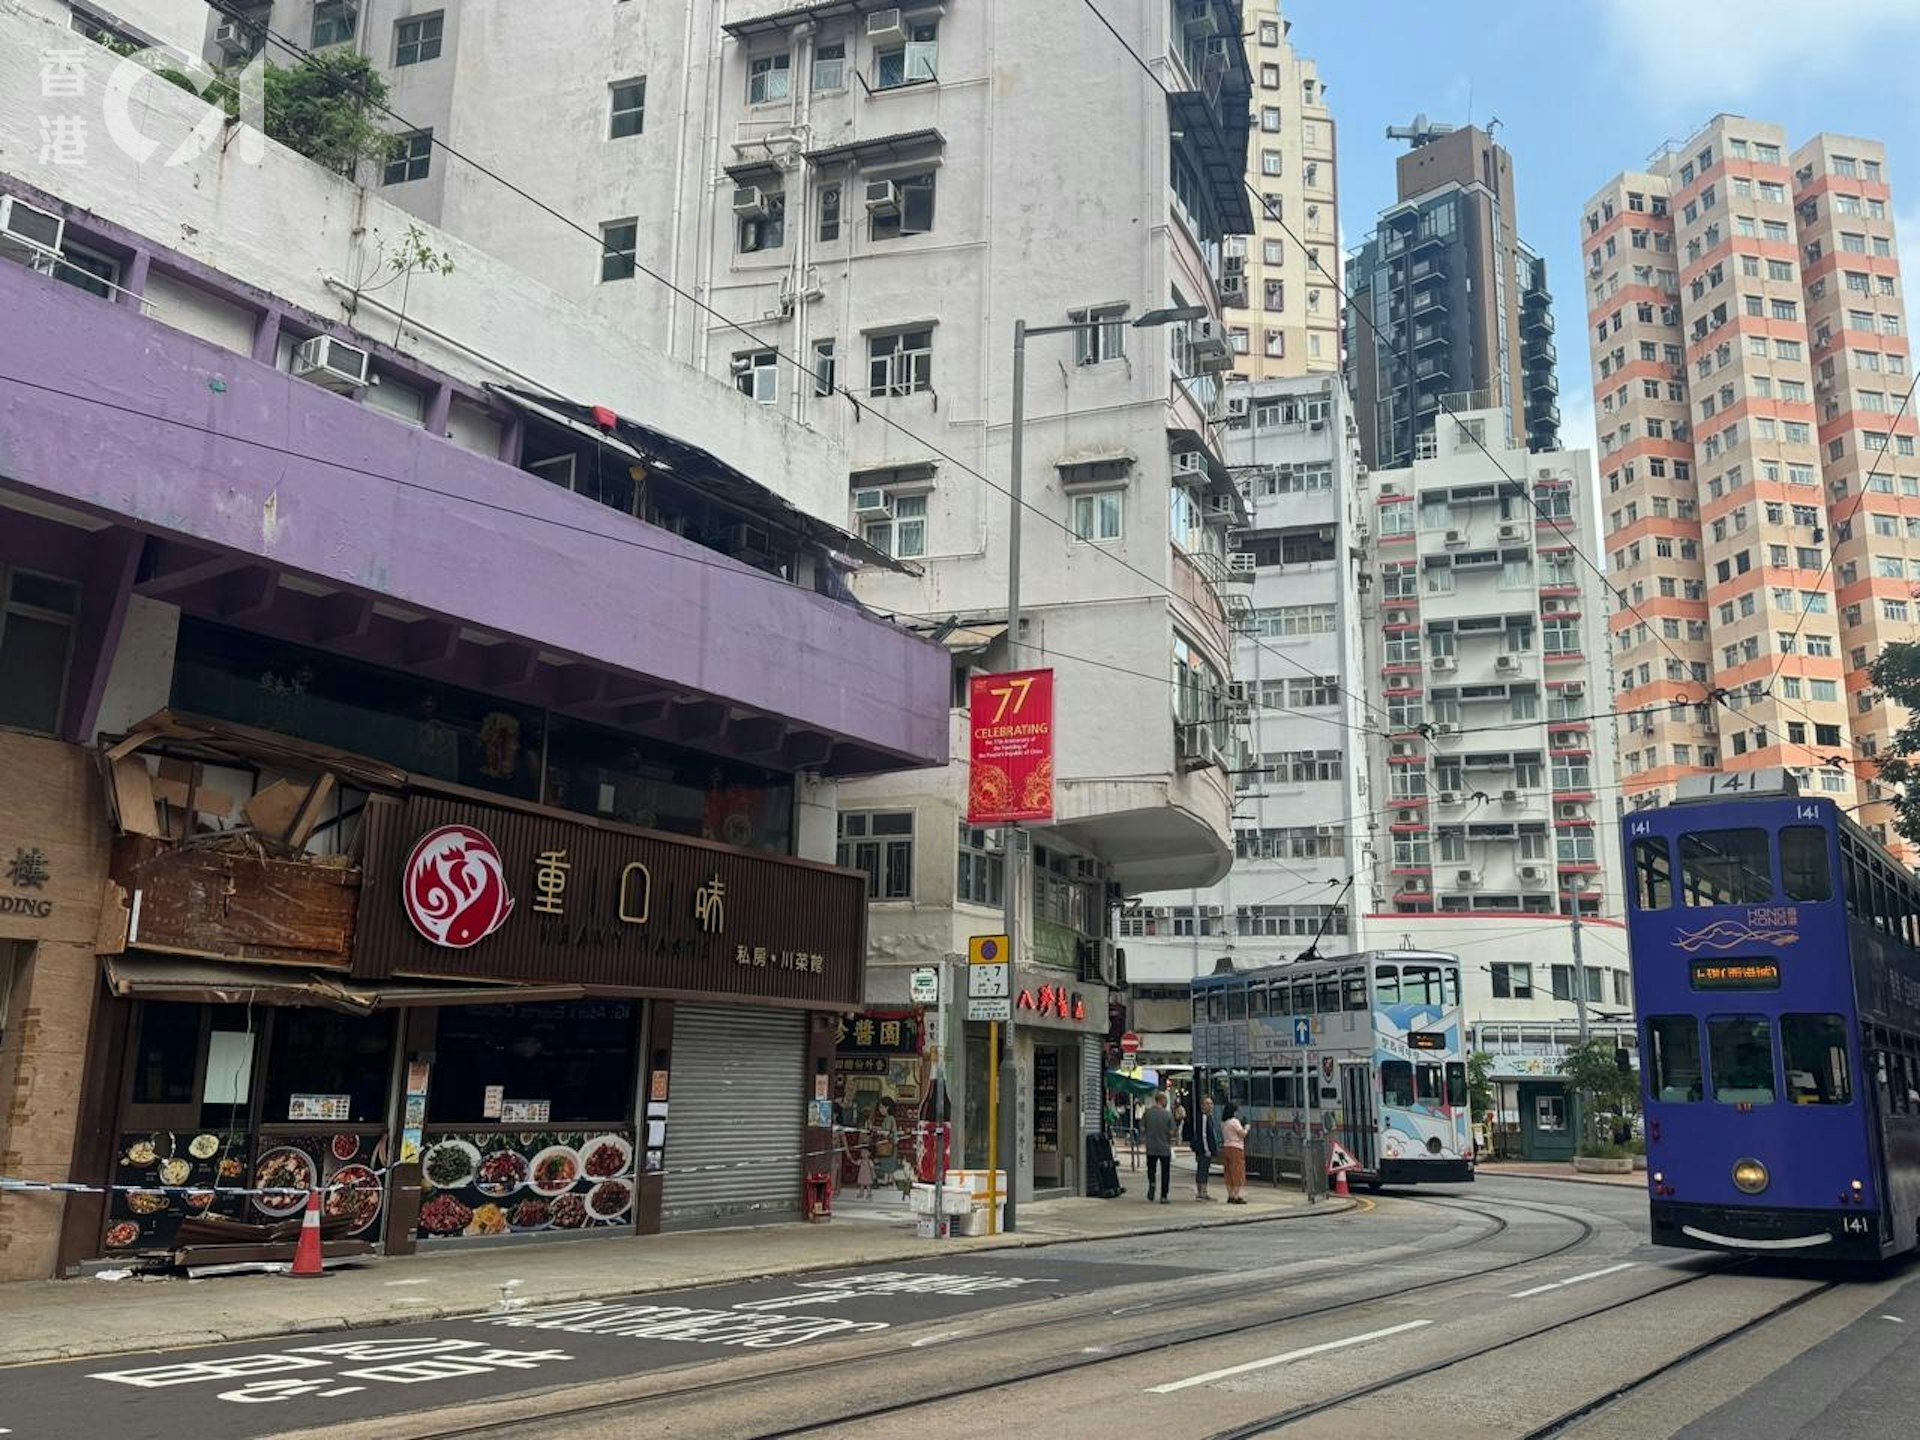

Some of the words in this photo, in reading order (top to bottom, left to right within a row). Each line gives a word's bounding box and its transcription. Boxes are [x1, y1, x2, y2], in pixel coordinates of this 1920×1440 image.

[989, 677, 1035, 724] 77
[974, 722, 1048, 739] CELEBRATING
[1709, 773, 1756, 794] 141
[1797, 805, 1819, 820] 141
[1631, 820, 1650, 835] 141
[5, 847, 50, 890] 樓
[533, 849, 726, 934] 重口味
[1746, 907, 1788, 918] HONG
[1748, 917, 1788, 927] KONG
[1843, 1216, 1869, 1233] 141
[732, 1289, 895, 1311] OF
